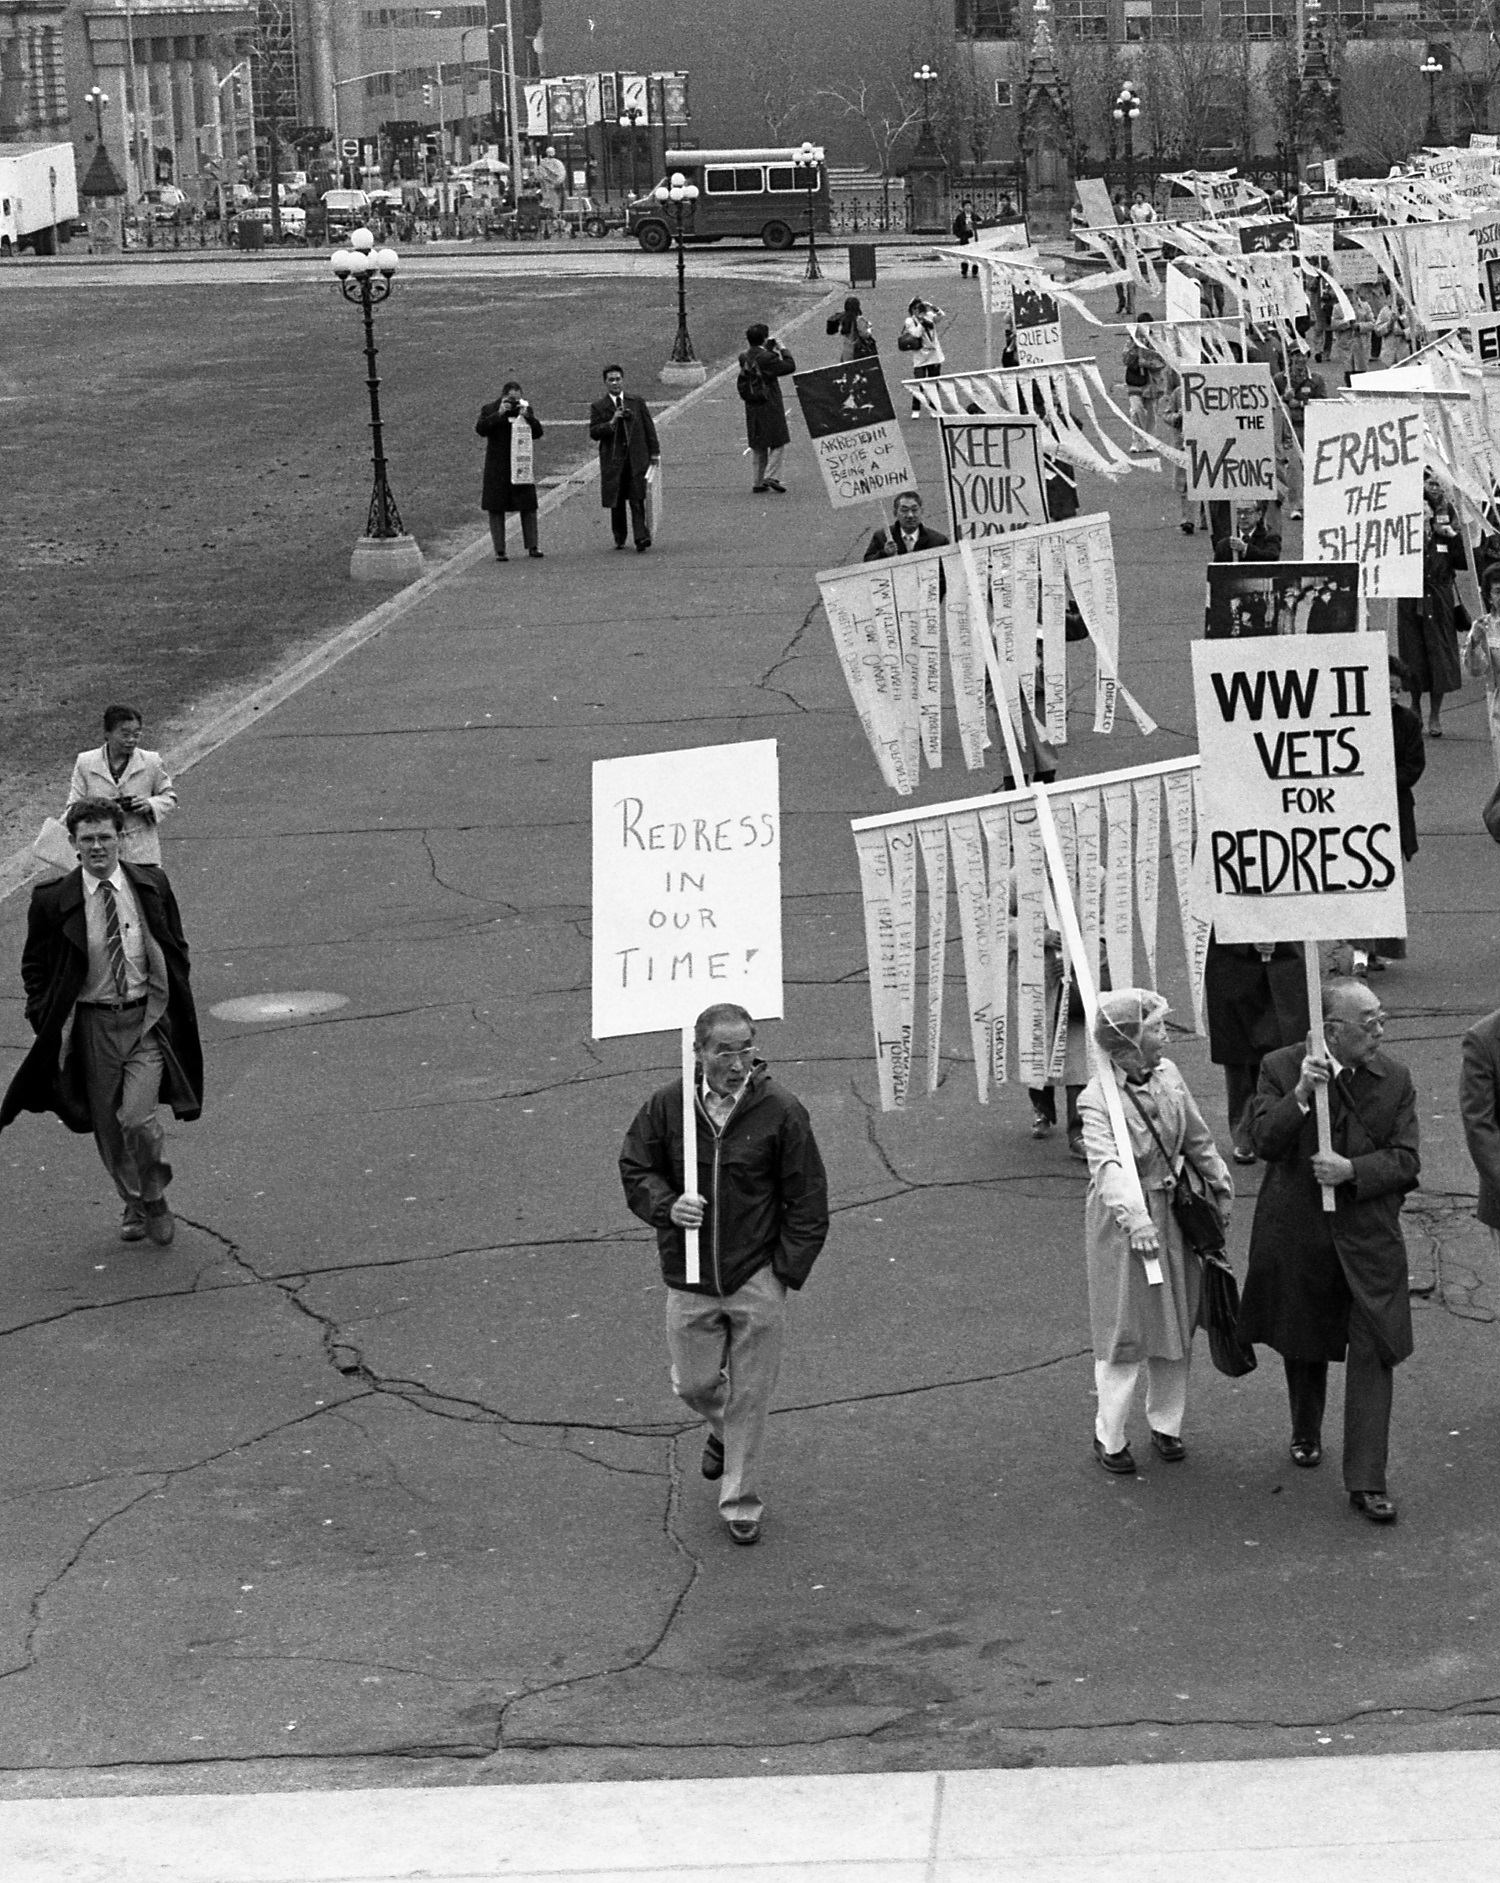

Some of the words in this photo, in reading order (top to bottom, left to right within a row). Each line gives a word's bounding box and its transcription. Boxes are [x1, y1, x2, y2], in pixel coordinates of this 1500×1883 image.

[1429, 161, 1453, 177] KEEP
[1212, 182, 1240, 199] KEEP
[1018, 328, 1059, 346] QUELS
[1182, 372, 1269, 415] REDRESS
[1236, 416, 1265, 429] THE
[820, 431, 872, 455] ARRESTED
[874, 427, 888, 442] IN
[826, 448, 867, 469] SPITE
[874, 443, 894, 455] OF
[947, 426, 1026, 469] KEEP
[1313, 413, 1419, 485] ERASE
[831, 465, 865, 483] BEING
[871, 462, 879, 471] A
[1186, 438, 1273, 490] WRONG
[839, 468, 908, 498] CANADIAN
[951, 474, 1030, 518] YOUR
[1344, 481, 1391, 515] THE
[1318, 512, 1422, 562] SHAME
[1211, 669, 1319, 721] WW
[1331, 666, 1370, 717] II
[1254, 727, 1361, 779] VETS
[1283, 788, 1335, 813] FOR
[614, 798, 774, 852] REDRESS
[1212, 823, 1395, 894] REDRESS
[666, 872, 704, 892] IN
[649, 908, 716, 929] OUR
[616, 948, 759, 988] TIME!
